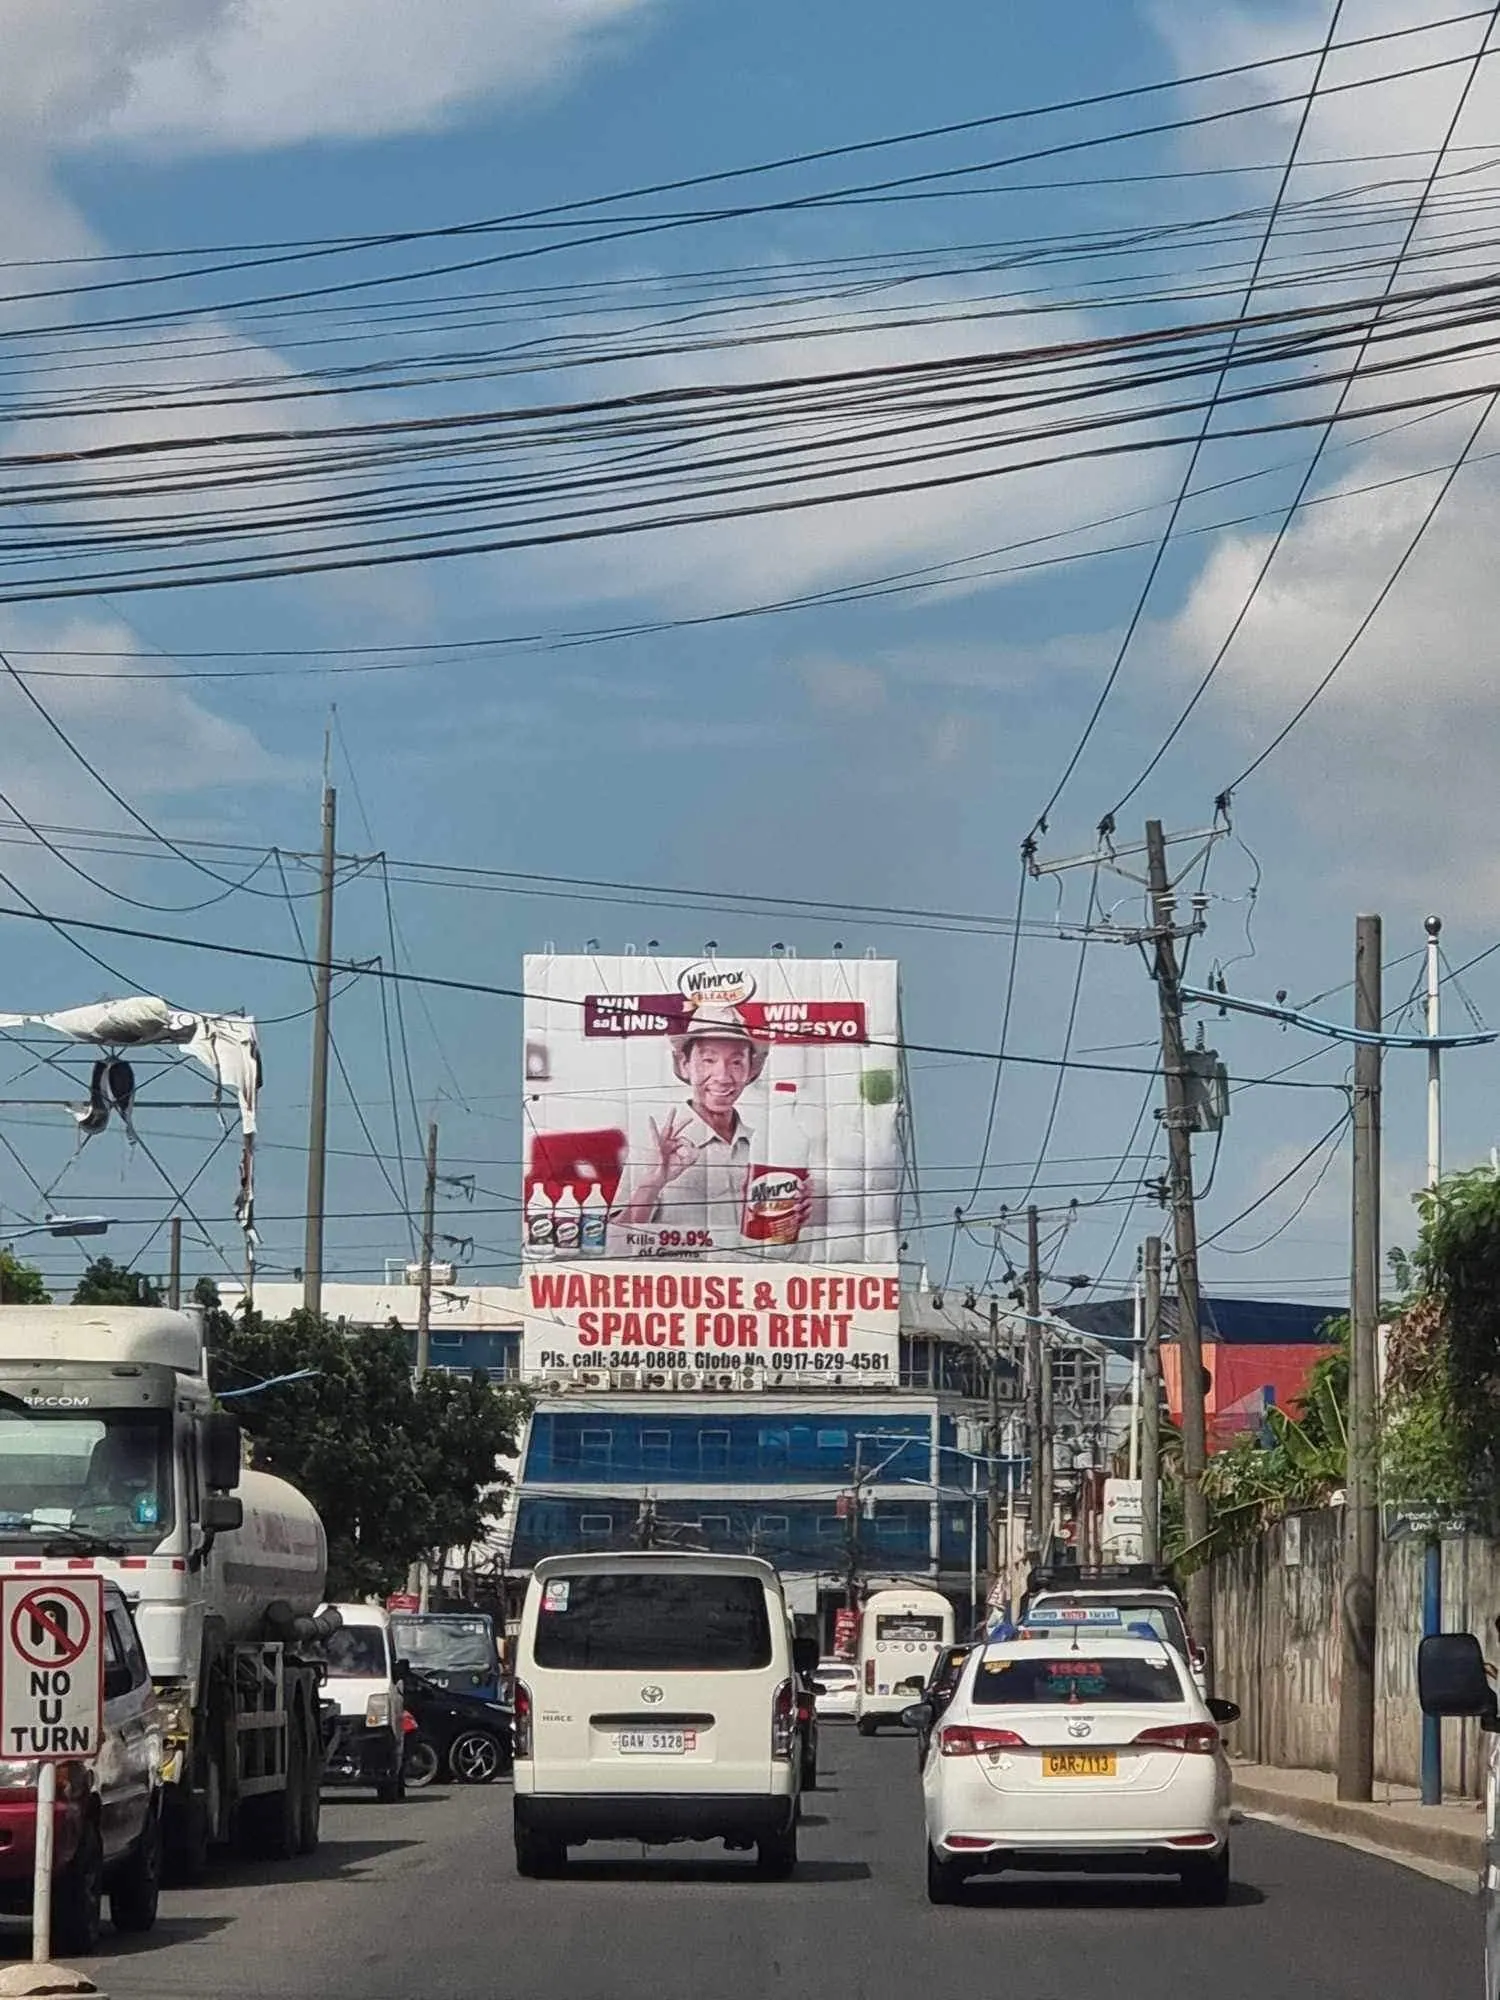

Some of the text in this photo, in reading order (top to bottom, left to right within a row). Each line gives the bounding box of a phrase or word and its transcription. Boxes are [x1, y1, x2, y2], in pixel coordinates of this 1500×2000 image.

[687, 970, 744, 990] Winrox
[596, 997, 640, 1013] WIN
[763, 1004, 808, 1021] WIN
[626, 1230, 713, 1246] Kills 99.9%
[529, 1274, 899, 1311] WAREHOUSE & OFFICE
[577, 1312, 853, 1349] SPACE FOR RENT
[540, 1350, 569, 1368] Pls.
[573, 1350, 607, 1368] call:
[695, 1352, 741, 1370] Globe
[745, 1352, 768, 1369] No.
[771, 1352, 890, 1371] 0917-629-4581
[30, 1670, 71, 1697] NO
[39, 1699, 63, 1725] U
[10, 1726, 90, 1753] TURN
[621, 1734, 683, 1748] GAW 5128
